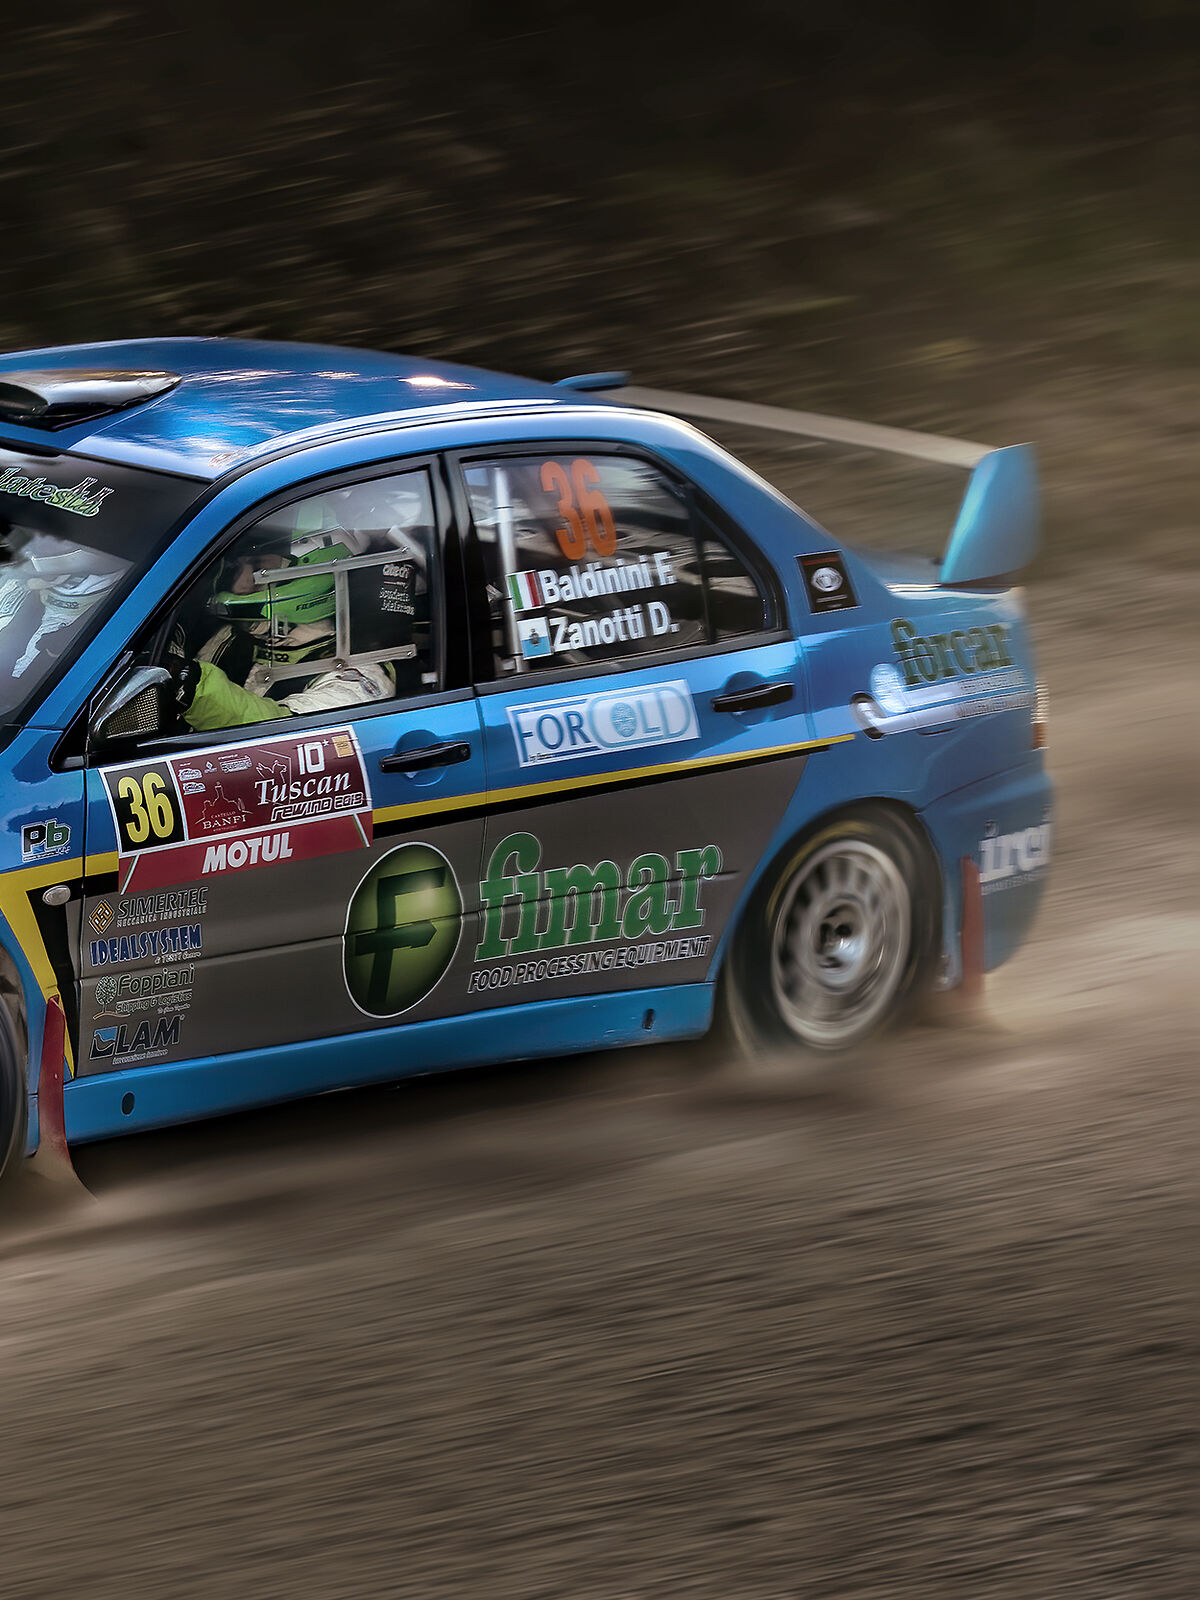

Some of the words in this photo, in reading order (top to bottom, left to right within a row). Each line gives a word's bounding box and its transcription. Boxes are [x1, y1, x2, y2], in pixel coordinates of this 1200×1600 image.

[540, 458, 617, 560] 36
[538, 553, 653, 605] Baldinini
[550, 603, 645, 652] Zanotti
[648, 601, 680, 636] D.
[118, 772, 175, 843] 36
[254, 772, 352, 807] Tuscan
[21, 817, 72, 855] Pb
[203, 814, 246, 830] BANFI
[201, 832, 294, 874] MOTUL
[116, 915, 157, 928] MECCANICA
[160, 905, 208, 921] INDUSTRIALE
[118, 887, 208, 919] SIMERTEC
[474, 832, 723, 963] fimar
[90, 923, 203, 967] IDEALSYSTEM
[468, 964, 517, 994] FOOD
[512, 949, 617, 985] PROCESSING
[614, 935, 712, 969] EQUIPMENT
[117, 963, 195, 997] Foppiani
[115, 1000, 149, 1014] Shipping
[158, 992, 192, 1006] Logistics
[115, 1015, 181, 1055] LAM
